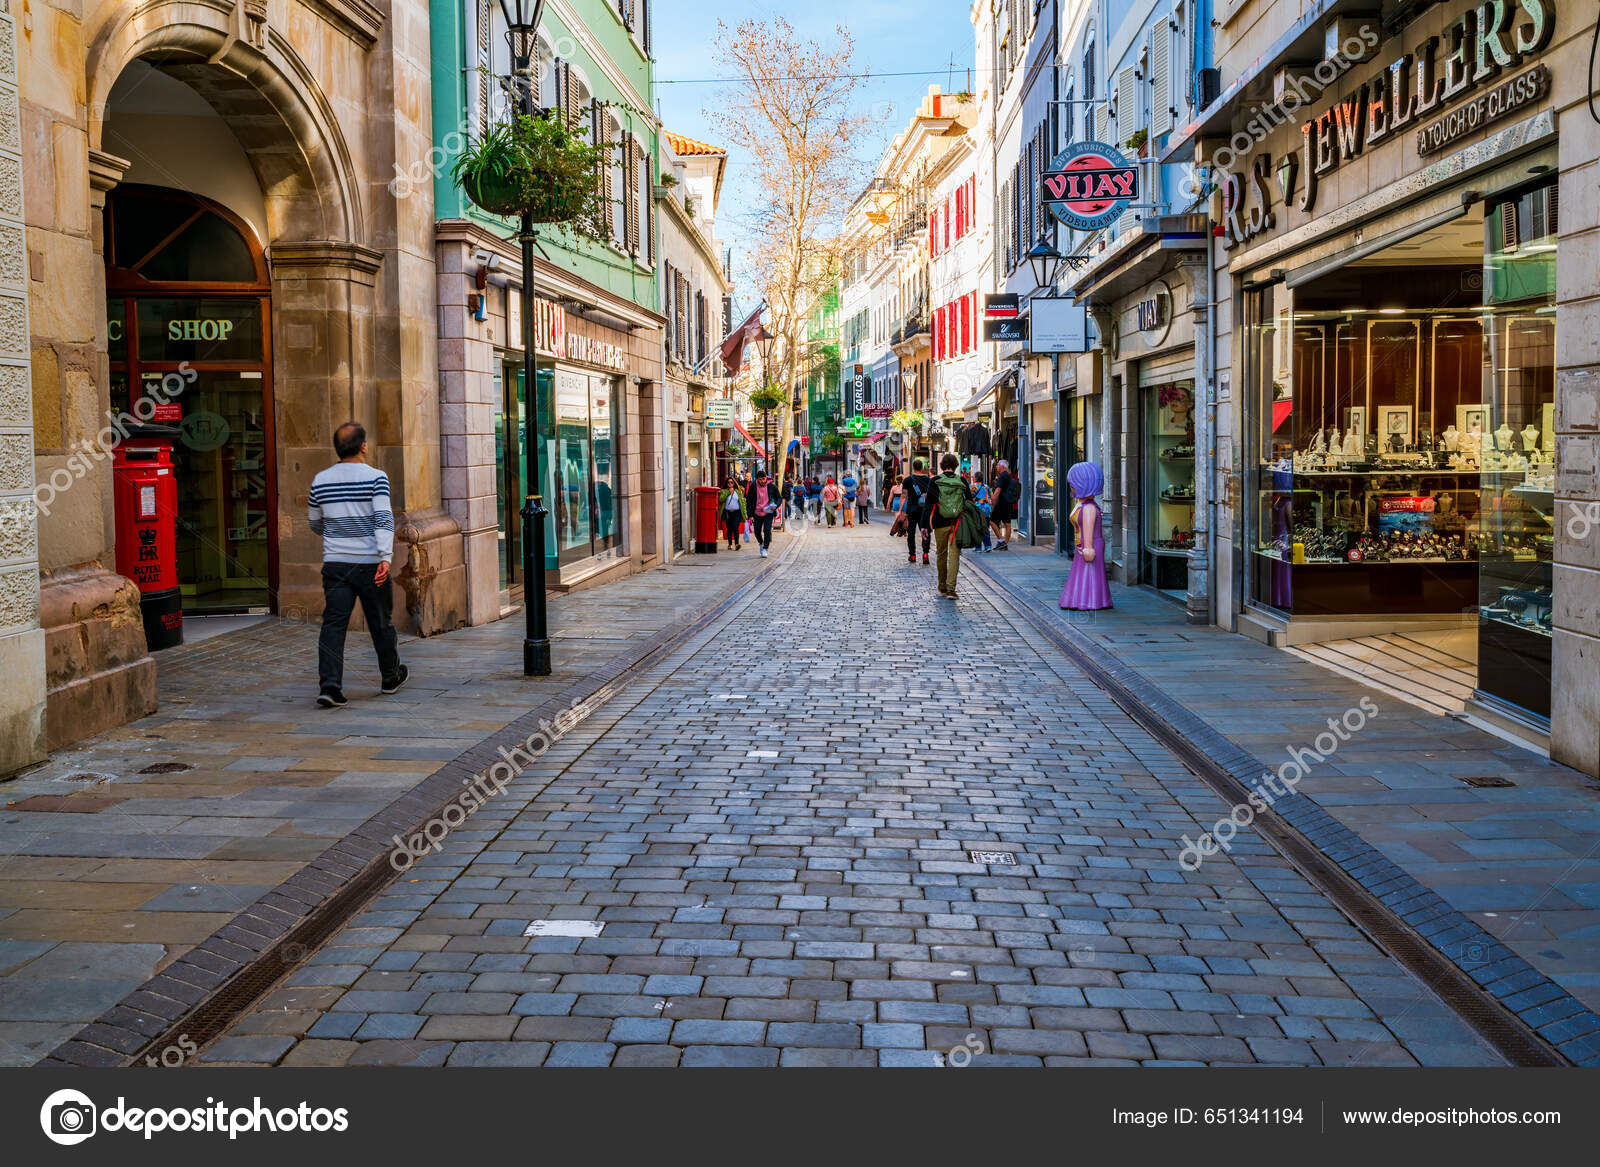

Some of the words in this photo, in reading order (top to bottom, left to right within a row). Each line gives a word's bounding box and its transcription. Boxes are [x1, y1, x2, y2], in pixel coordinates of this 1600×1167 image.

[1300, 0, 1552, 212] JEWELLERS
[1420, 130, 1427, 152] A
[1427, 108, 1465, 147] TOUCH
[1468, 99, 1486, 127] OF
[1488, 71, 1537, 117] CLASS
[1076, 144, 1105, 153] MUSIC
[1044, 171, 1134, 199] VIJAY
[168, 319, 234, 341] SHOP
[855, 374, 863, 411] CARLOS
[134, 564, 161, 576] ROYAL
[138, 573, 160, 584] MAIL
